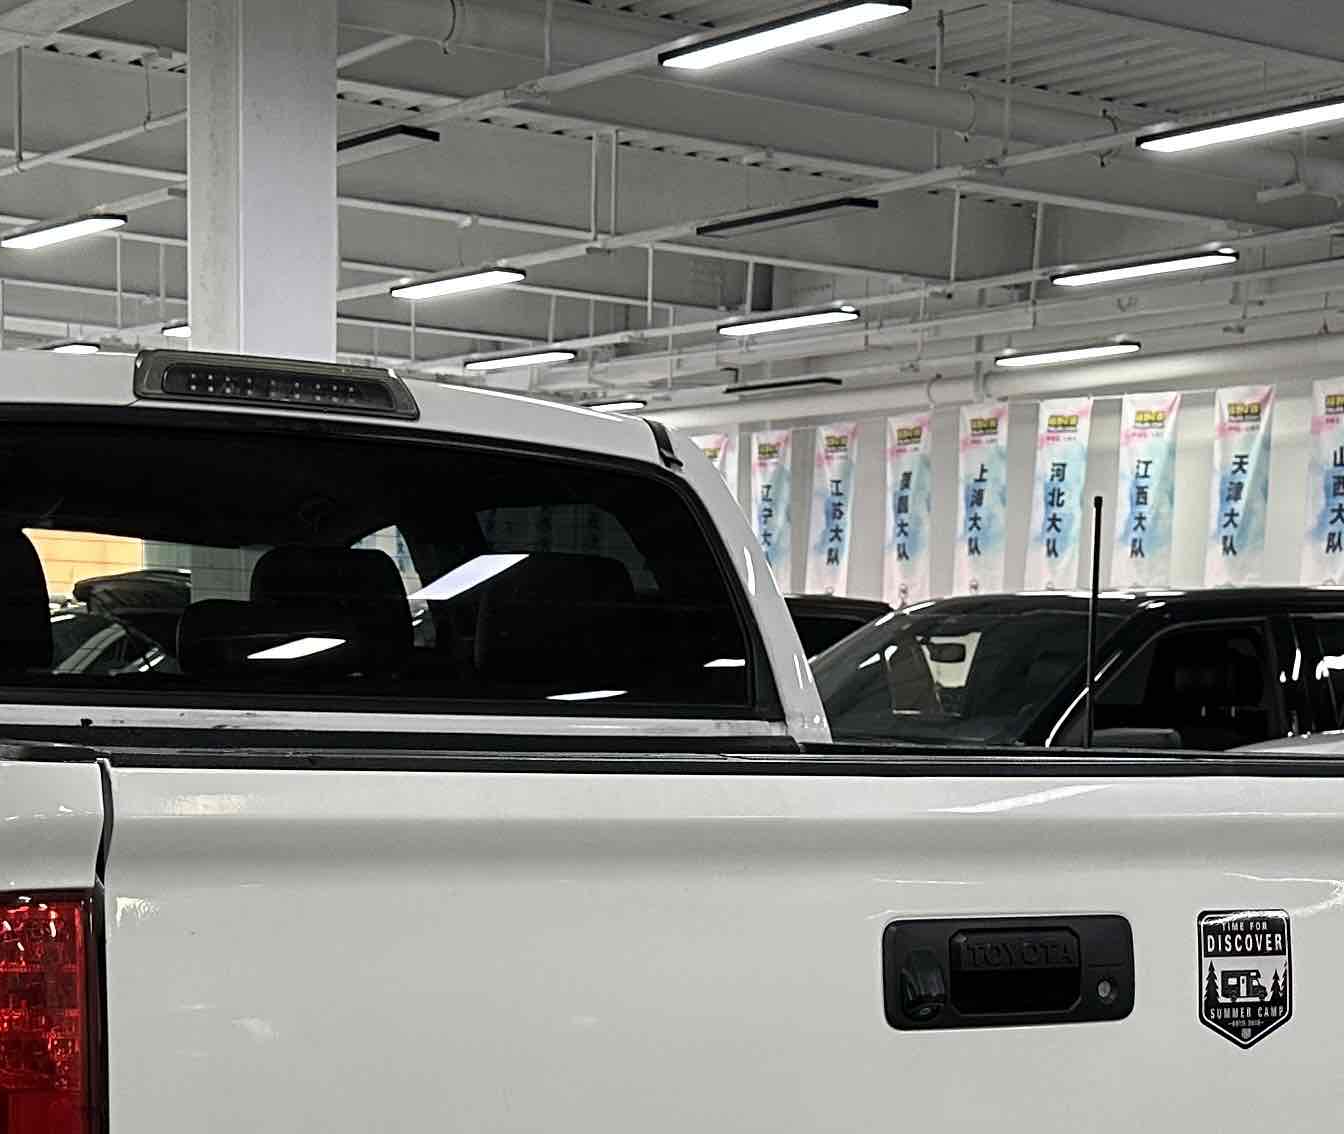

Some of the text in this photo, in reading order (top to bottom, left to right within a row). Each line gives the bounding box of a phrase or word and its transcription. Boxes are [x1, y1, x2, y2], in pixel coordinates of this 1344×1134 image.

[1222, 921, 1267, 931] TIME FOR
[1207, 933, 1282, 952] DISCOVER
[967, 943, 1073, 967] TOYOTA
[1210, 1006, 1284, 1019] SUMMER CAMP
